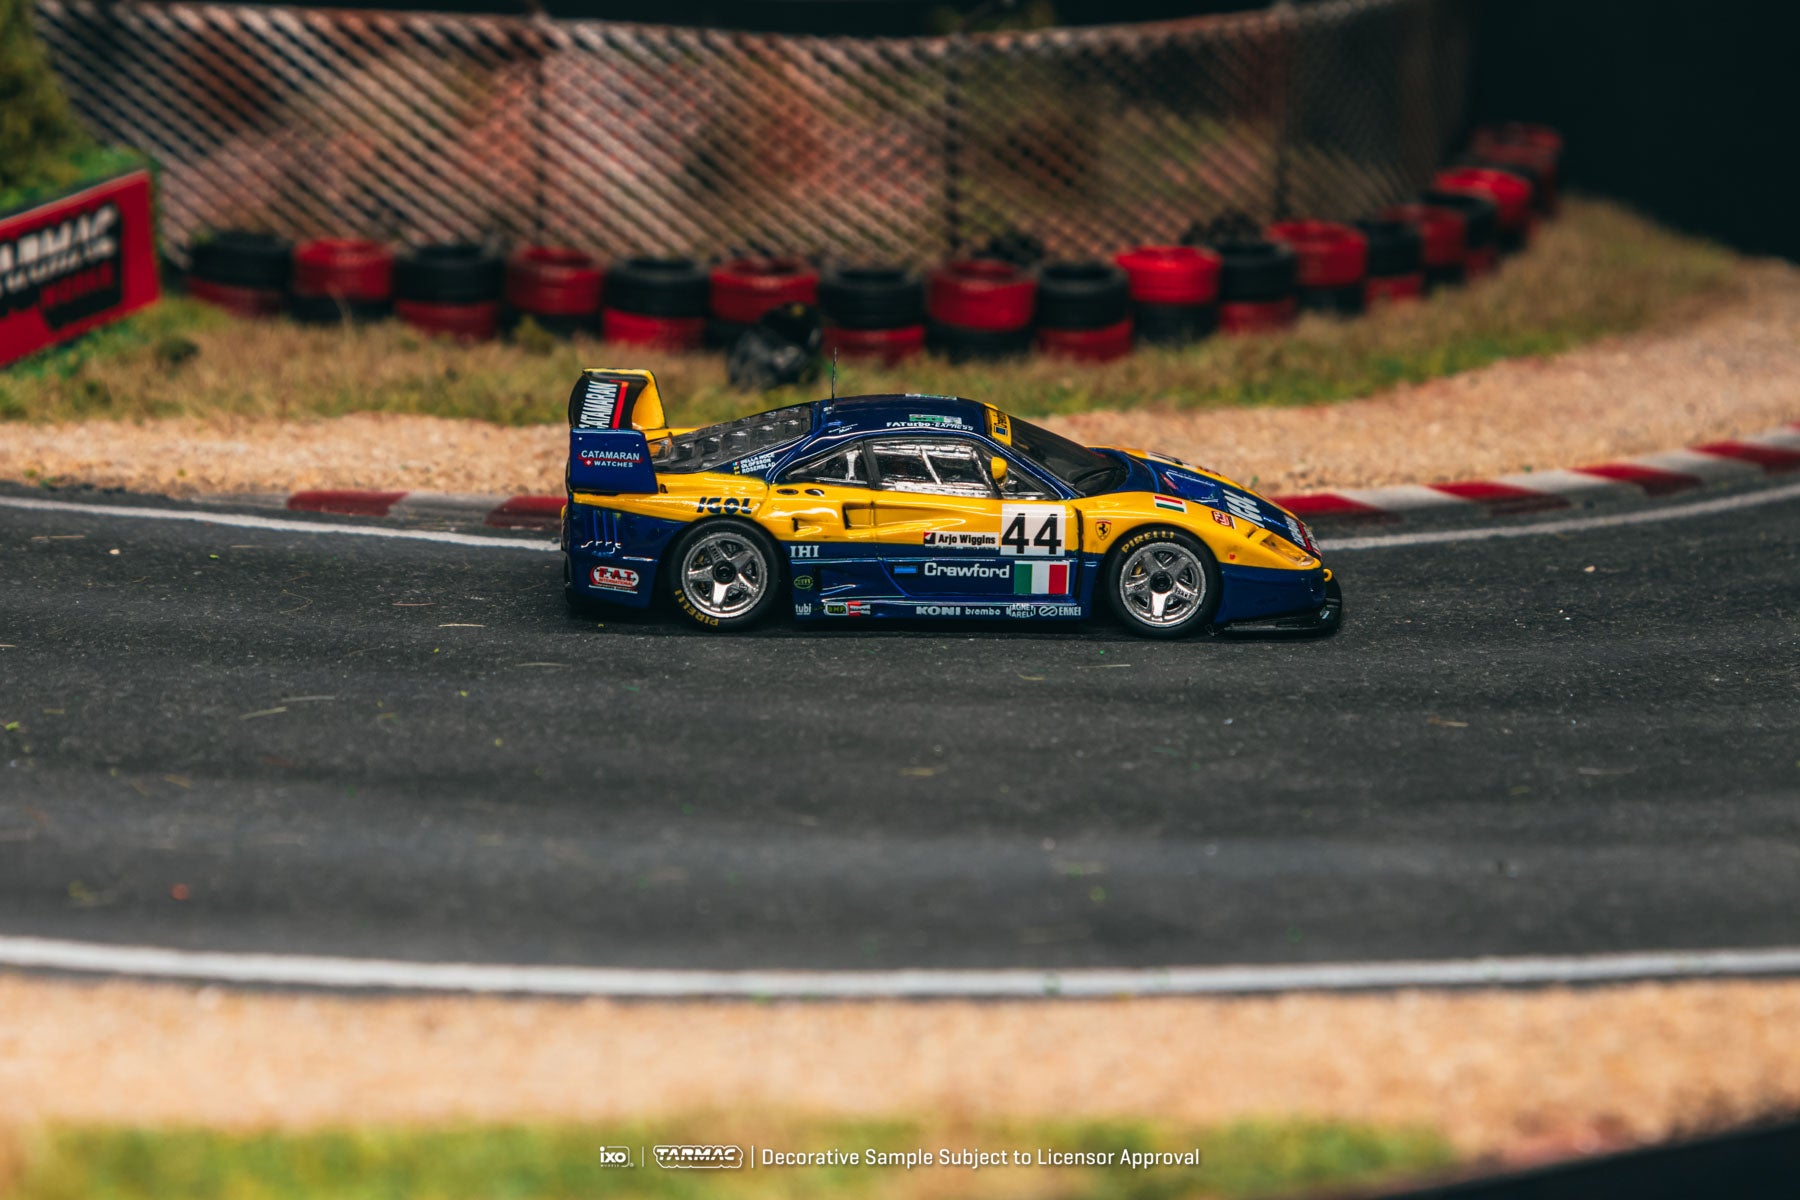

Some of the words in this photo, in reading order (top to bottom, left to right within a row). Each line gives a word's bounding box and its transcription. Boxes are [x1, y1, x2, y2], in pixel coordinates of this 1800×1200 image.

[581, 450, 640, 460] CATAMARAN
[594, 460, 633, 468] WATCHES
[697, 496, 752, 515] IGOL
[938, 534, 957, 545] Arjo
[959, 534, 996, 546] Wiggins
[1001, 513, 1062, 555] 44
[1121, 530, 1175, 553] PIRELLI
[790, 545, 820, 558] IHI
[924, 562, 1010, 579] Crawford
[674, 589, 719, 626] PIRELLI
[795, 603, 811, 613] tubi
[916, 606, 961, 616] KONI
[965, 606, 1001, 616] brembo
[1059, 606, 1082, 616] ENKEI
